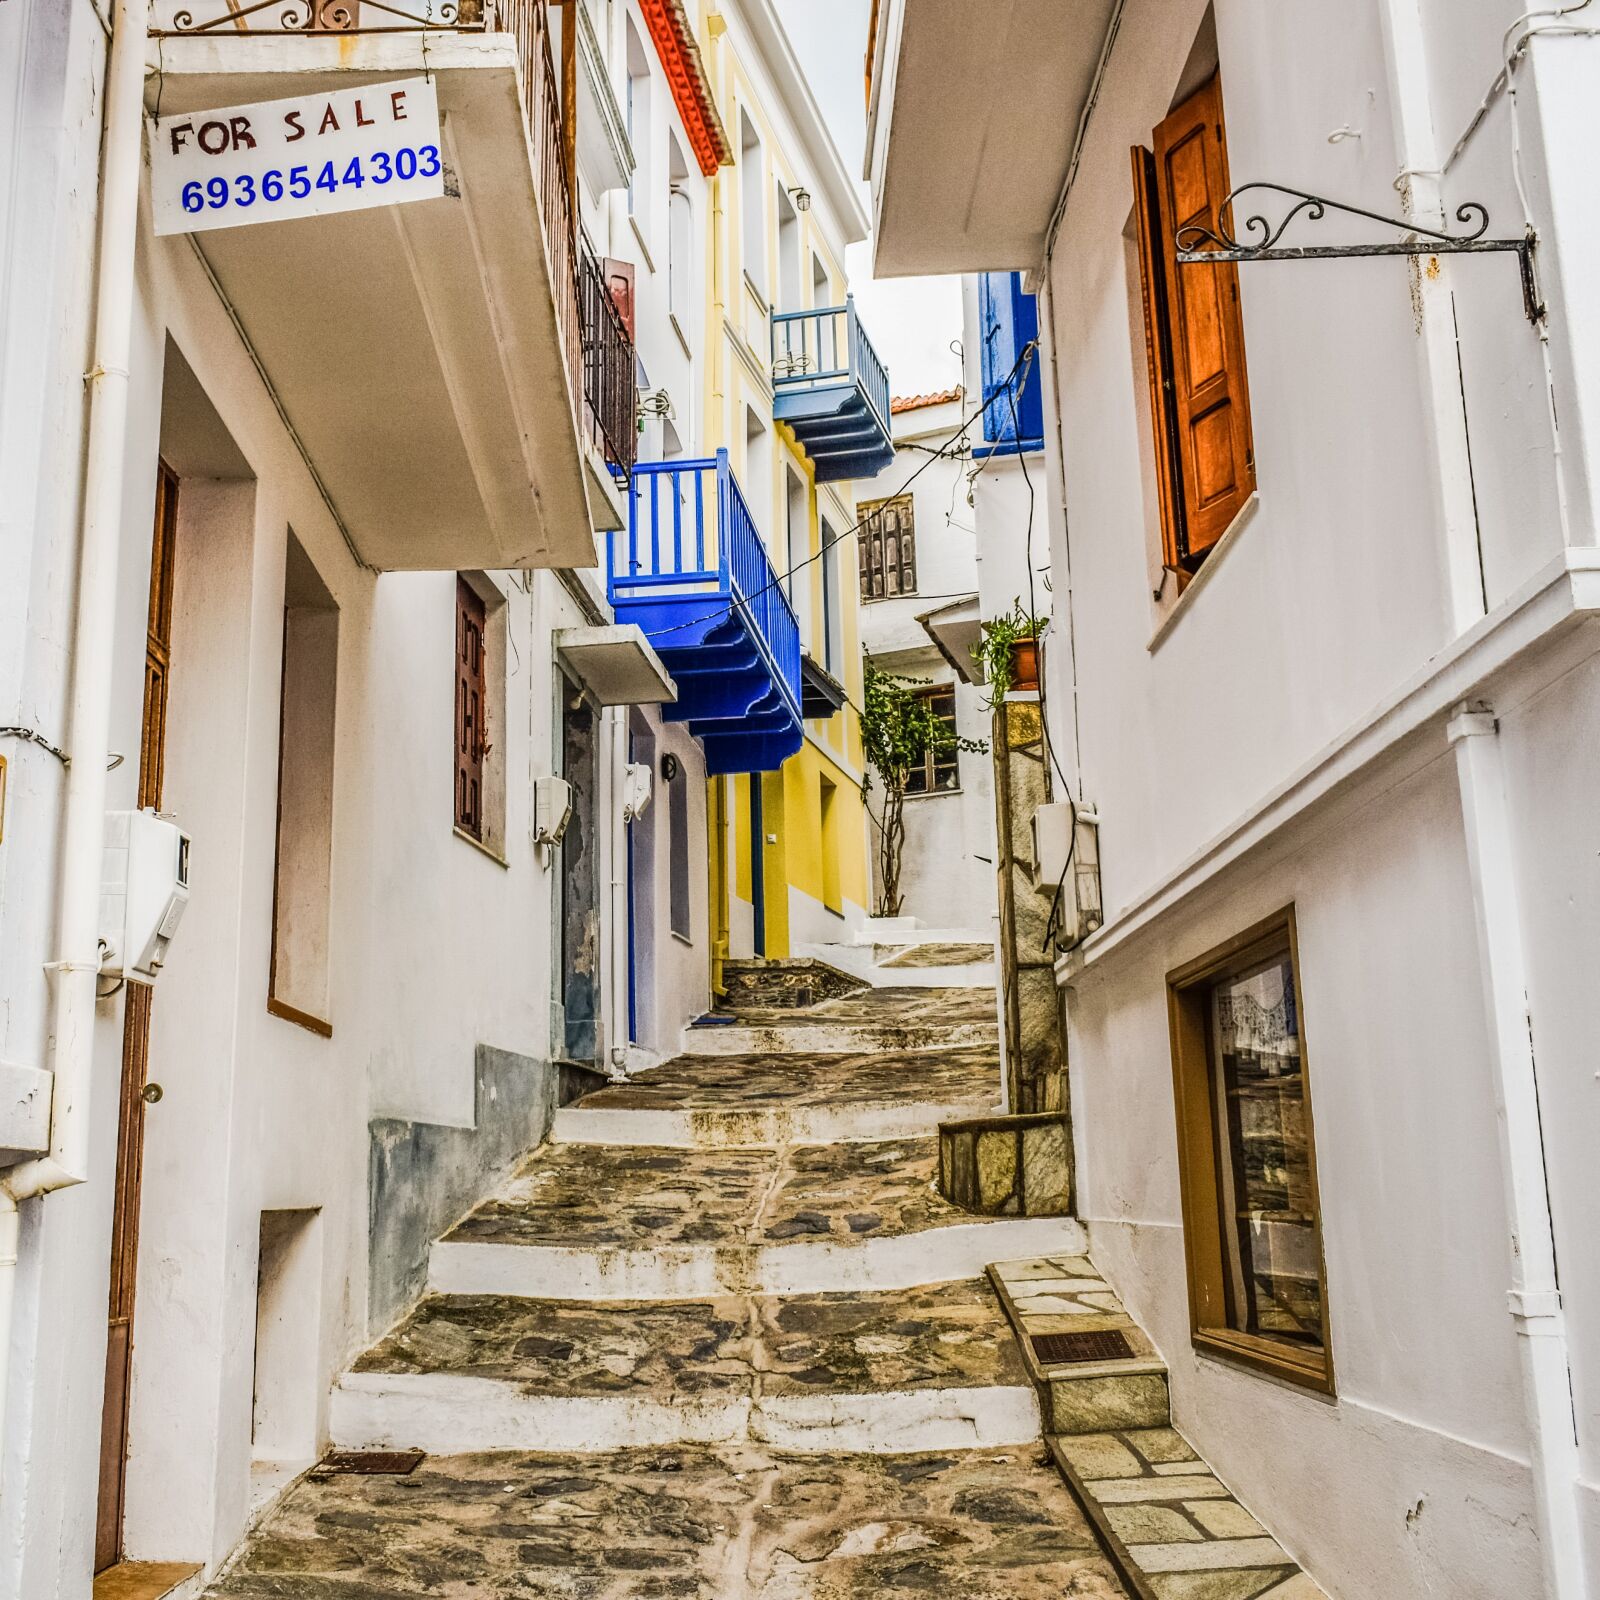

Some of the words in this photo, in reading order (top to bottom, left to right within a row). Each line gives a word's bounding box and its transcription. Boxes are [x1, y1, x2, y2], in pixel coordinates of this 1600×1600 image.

[170, 116, 257, 155] FOR
[284, 91, 408, 142] SALE
[181, 145, 441, 213] 6936544303
